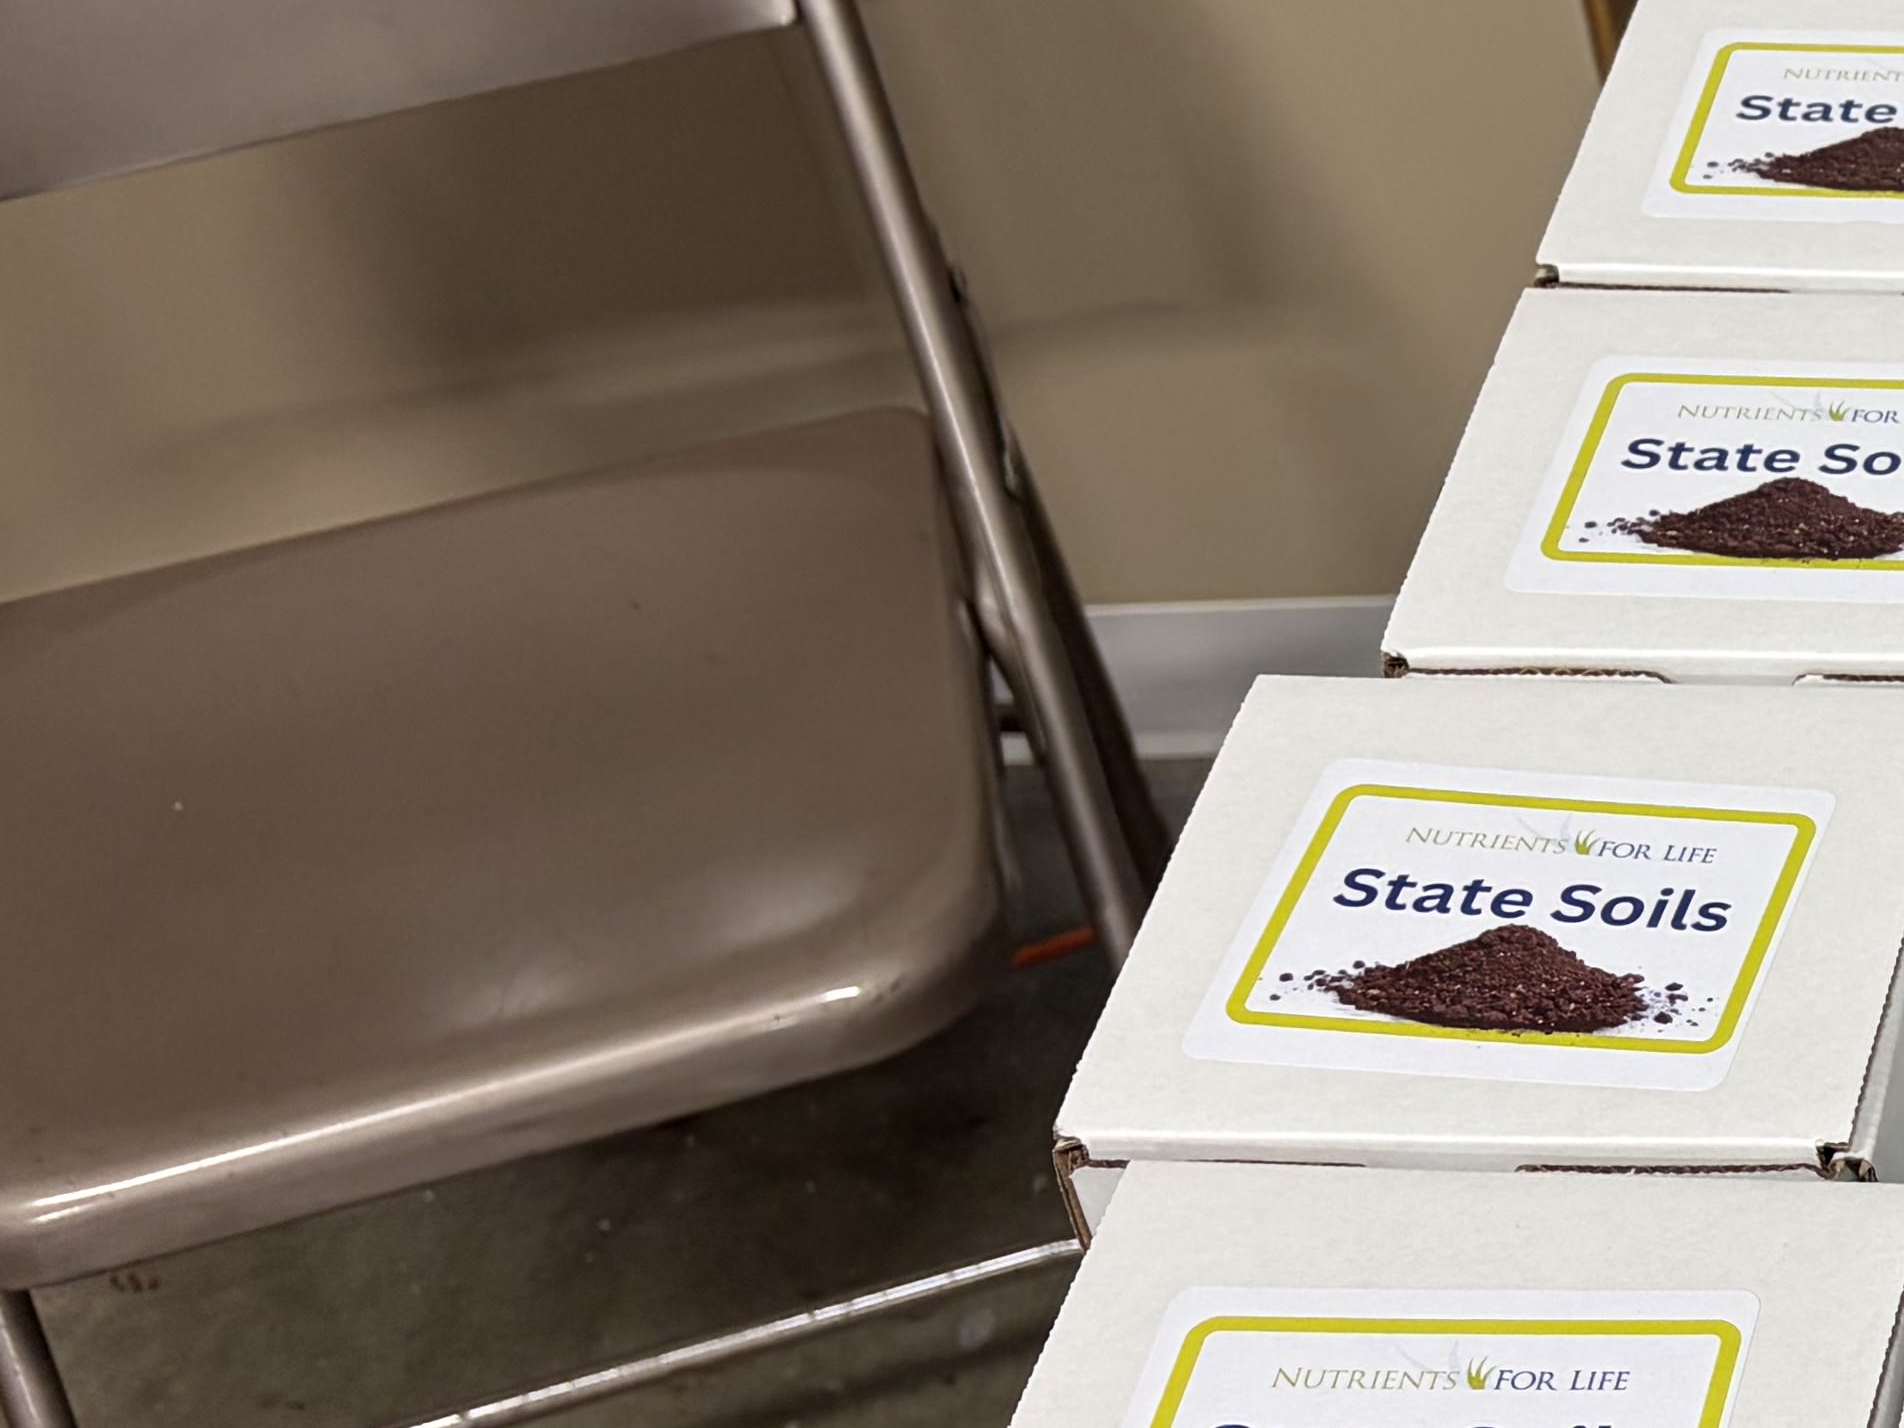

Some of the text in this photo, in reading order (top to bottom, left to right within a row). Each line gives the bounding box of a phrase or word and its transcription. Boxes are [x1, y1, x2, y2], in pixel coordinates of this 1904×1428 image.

[1735, 94, 1897, 123] State
[1677, 404, 1824, 421] NUTRIENTS
[1850, 408, 1899, 423] FOR
[1620, 438, 1801, 473] State
[1406, 828, 1718, 864] NUTRIENTS FOR LIFE
[1333, 869, 1732, 932] State Soils
[1271, 1367, 1630, 1391] NUTRIENTS FOR LIFE
